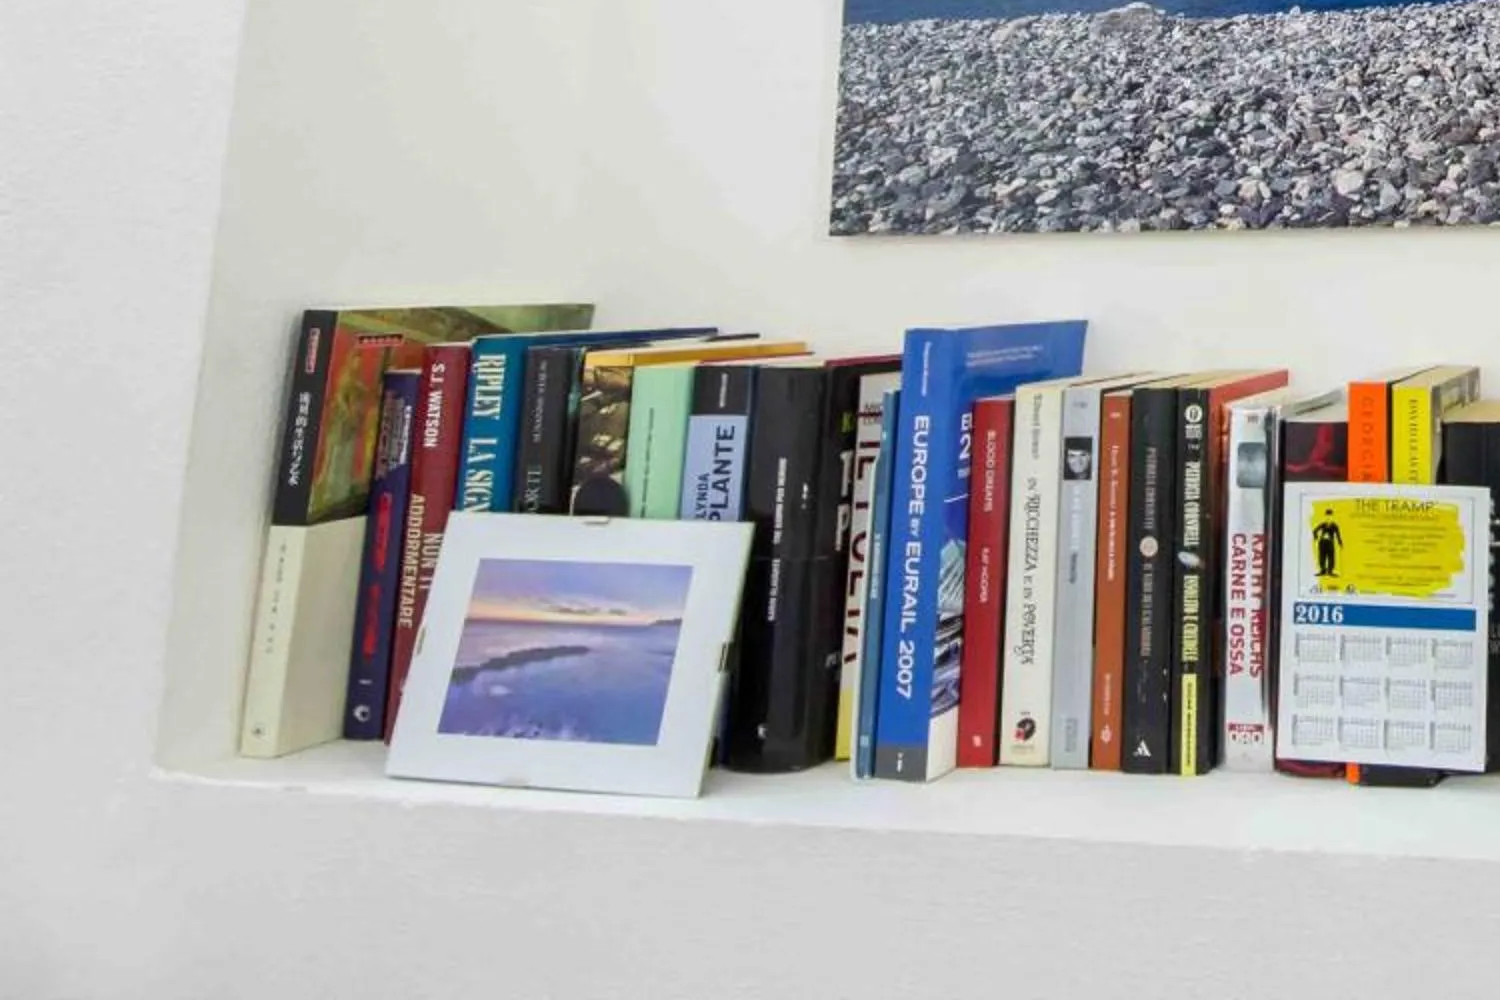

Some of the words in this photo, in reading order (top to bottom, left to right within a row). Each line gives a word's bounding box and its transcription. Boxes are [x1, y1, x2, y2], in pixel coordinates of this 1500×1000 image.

[471, 353, 507, 420] RIPLEY
[422, 389, 442, 448] WATSON
[467, 438, 498, 465] LA
[908, 415, 930, 515] EUROPE
[985, 429, 996, 467] BLOOD
[462, 469, 496, 513] SIGN
[1353, 498, 1380, 513] THE
[1384, 499, 1435, 513] TRAMP
[909, 518, 921, 537] BY
[1024, 494, 1042, 572] RICCHEZZA
[398, 494, 425, 629] ADDORMENTARE
[900, 540, 922, 633] EURAIL
[1024, 575, 1034, 584] E
[1230, 532, 1248, 600] CARNE
[1230, 608, 1246, 618] E
[1295, 605, 1343, 624] 2016
[896, 640, 916, 699] 2007
[1229, 623, 1246, 676] OSSA
